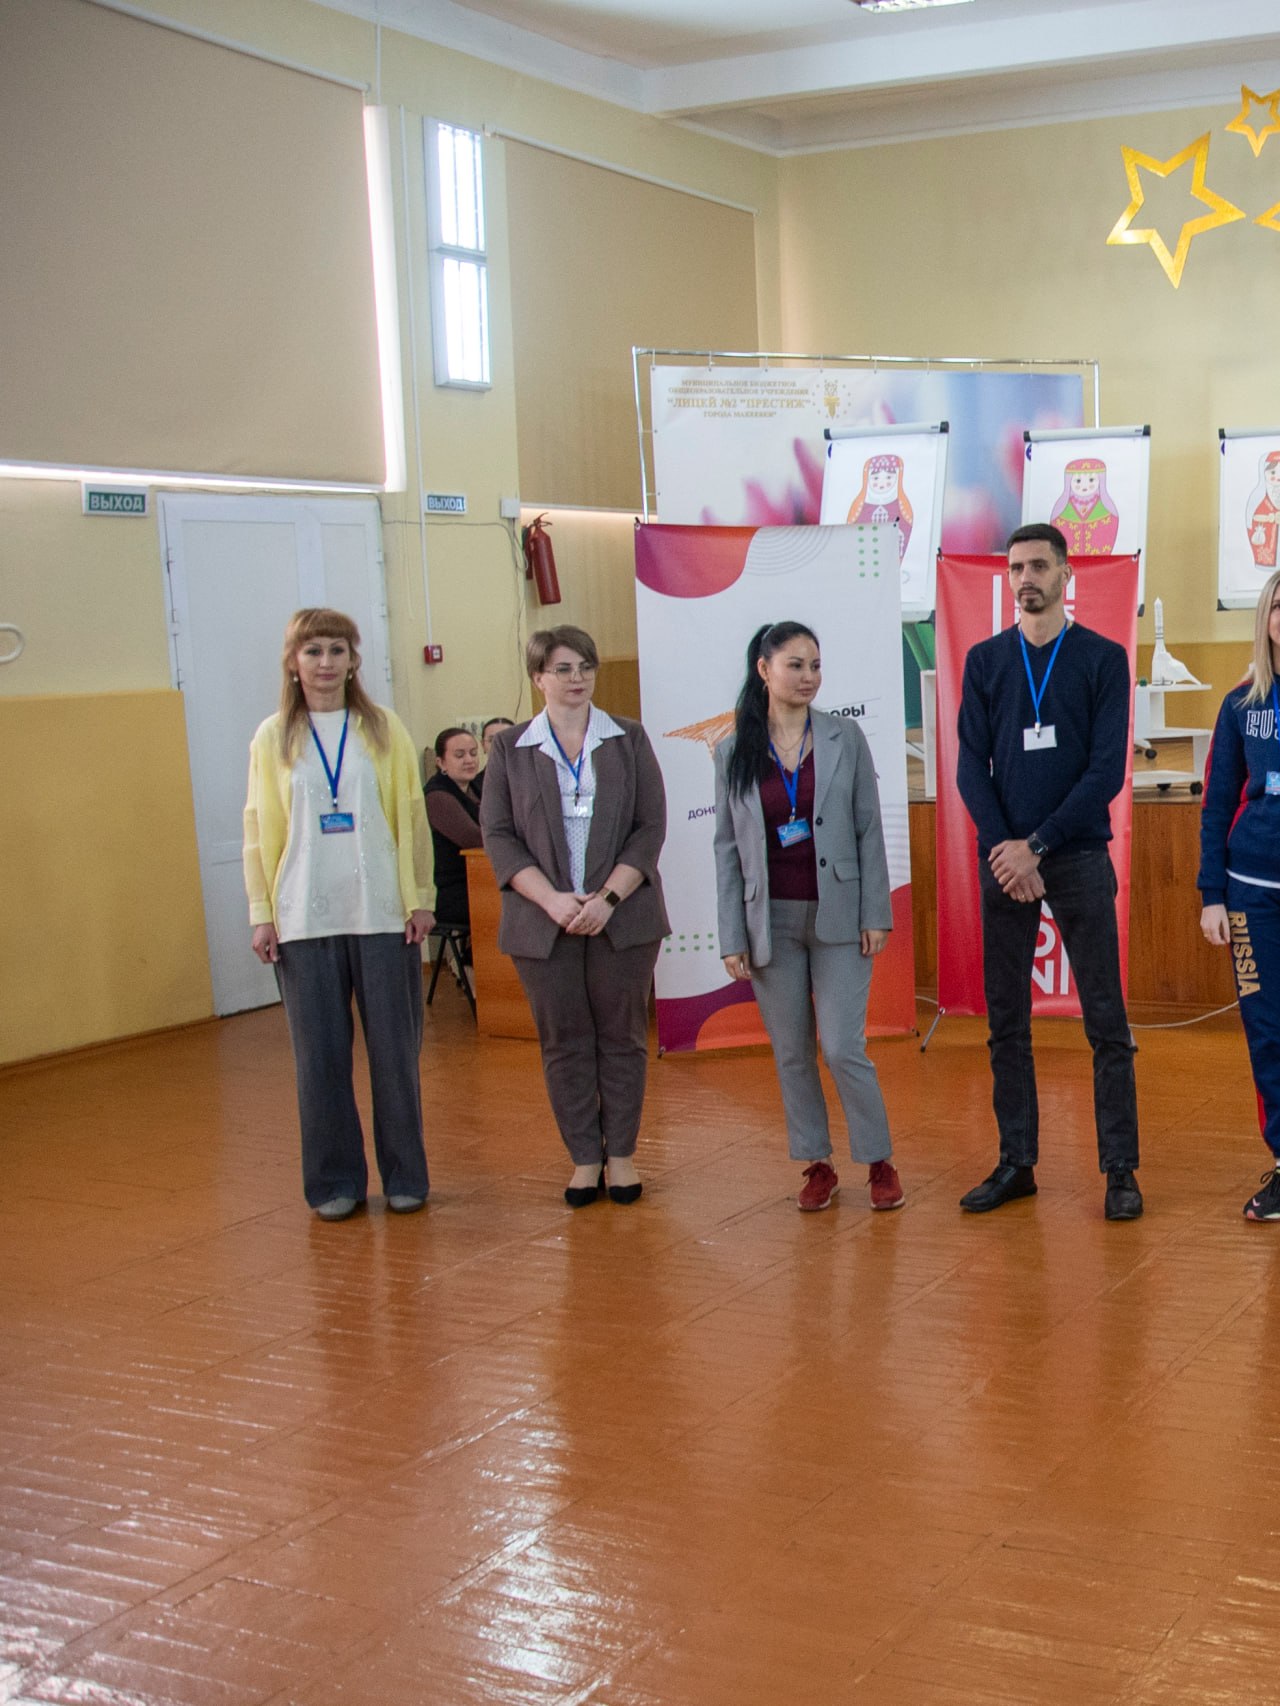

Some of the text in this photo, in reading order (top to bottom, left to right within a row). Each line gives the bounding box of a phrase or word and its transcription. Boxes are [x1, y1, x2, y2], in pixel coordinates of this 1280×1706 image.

[667, 396, 717, 408] "ЛИЦЕЙ
[740, 398, 811, 409] "ПРЕСТИЖ"
[90, 494, 143, 511] ВЫХОД
[428, 496, 463, 511] ВЫХОД
[1228, 911, 1261, 998] RUSSIA
